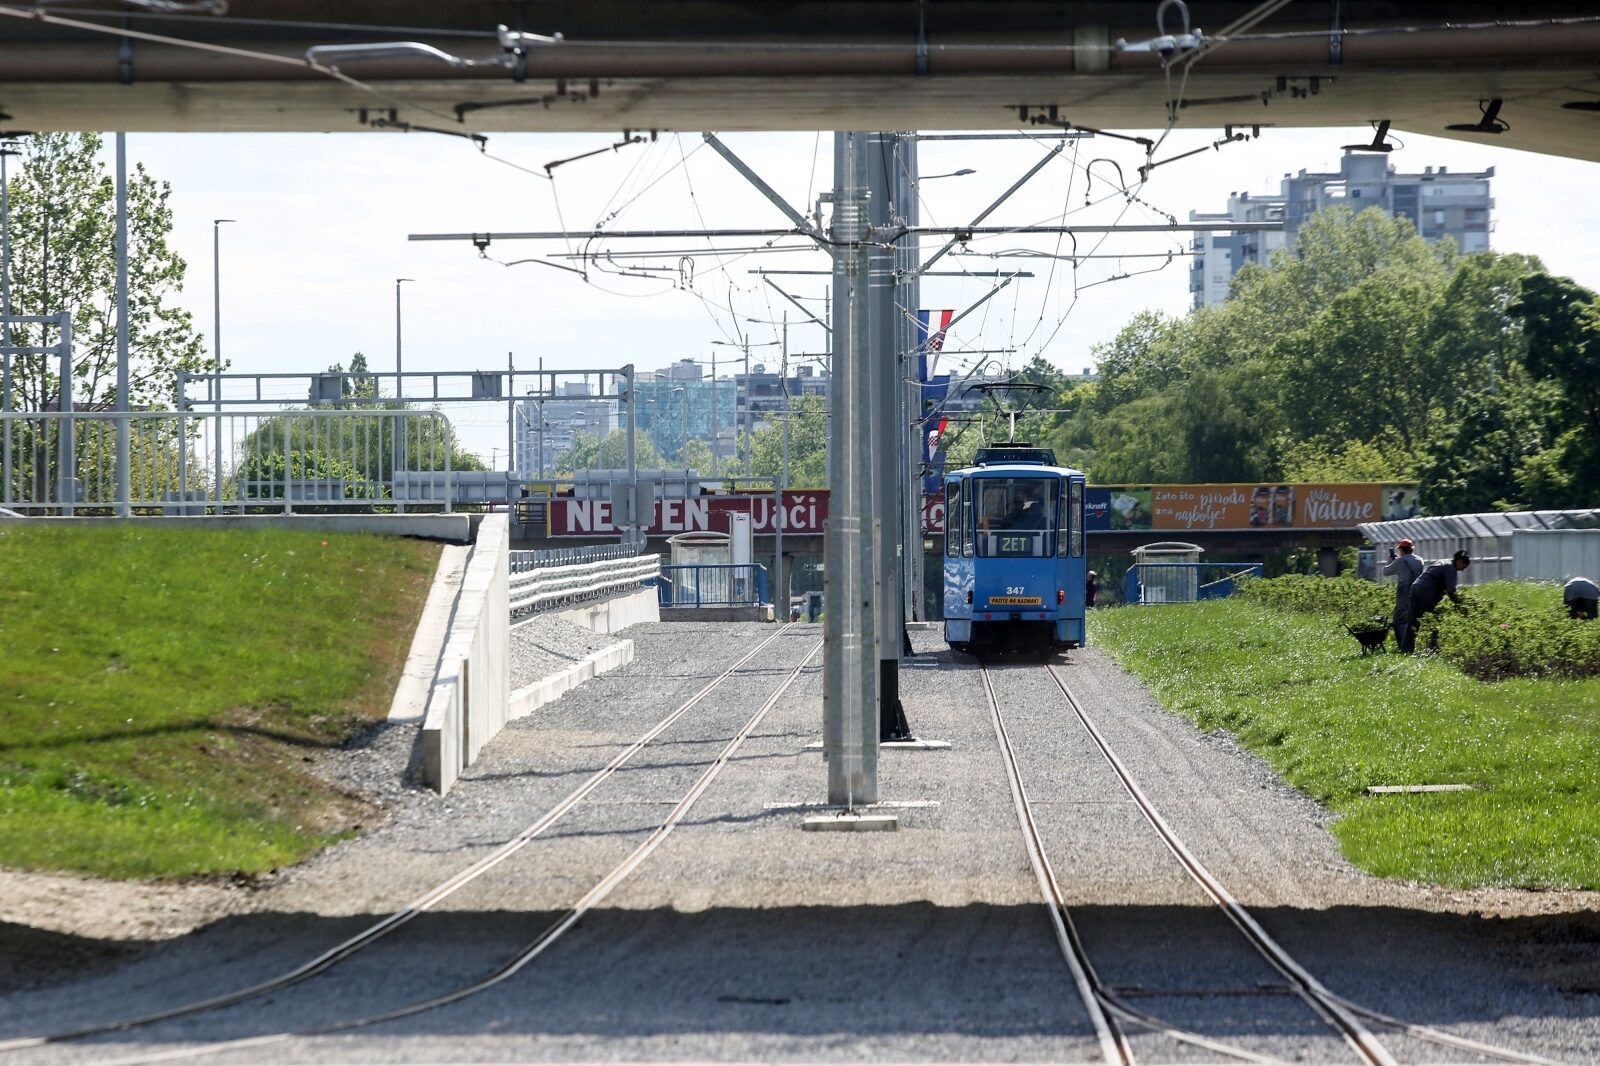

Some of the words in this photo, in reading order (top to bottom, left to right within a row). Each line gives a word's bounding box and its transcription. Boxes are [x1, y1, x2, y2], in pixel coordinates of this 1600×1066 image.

[1155, 491, 1177, 501] Zato
[1179, 490, 1195, 500] što
[1200, 487, 1246, 510] priroda
[1304, 493, 1375, 525] Nature
[566, 499, 709, 532] NEEN
[752, 495, 817, 530] Jači
[1156, 508, 1173, 516] zna
[1175, 504, 1227, 529] najbolje!
[1002, 537, 1027, 552] ZET
[1006, 586, 1025, 595] 347
